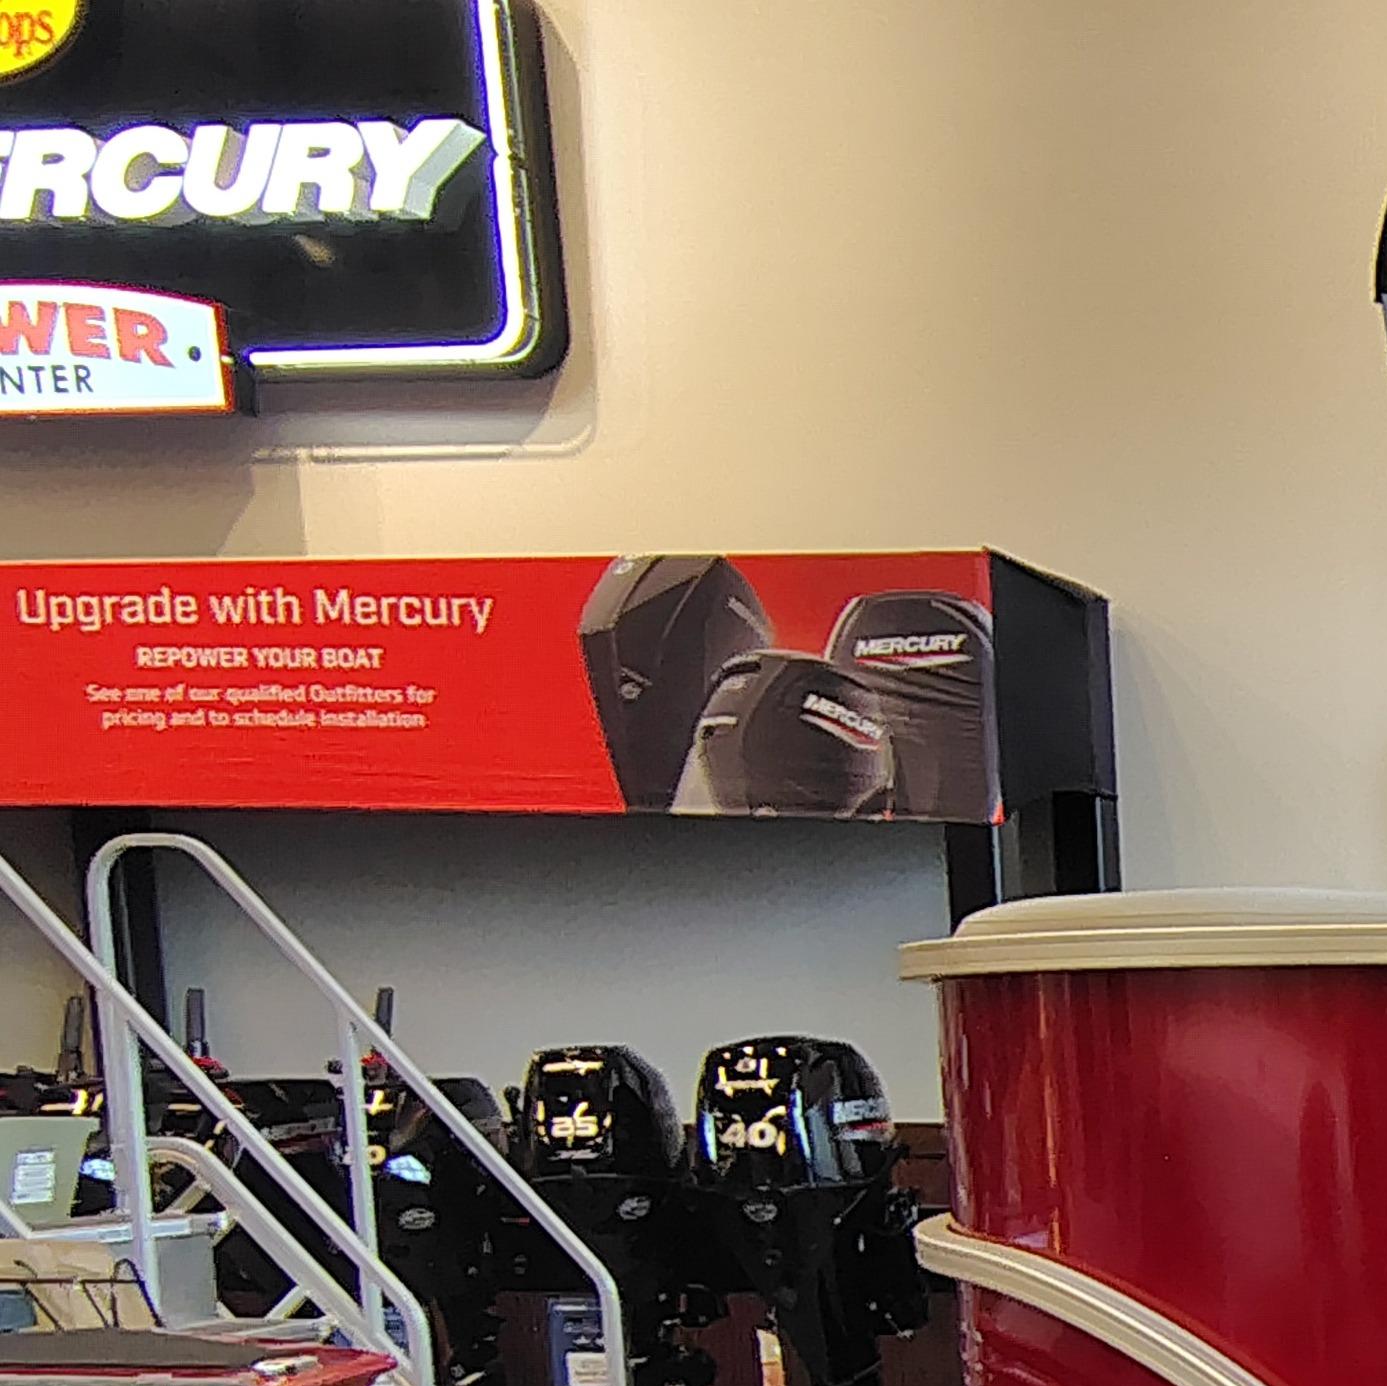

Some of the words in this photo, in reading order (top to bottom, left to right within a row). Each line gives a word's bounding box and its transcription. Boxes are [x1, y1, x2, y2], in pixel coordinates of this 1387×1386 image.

[0, 118, 486, 222] RCURY
[16, 587, 199, 632] Upgrade
[209, 587, 302, 625] with
[314, 588, 493, 634] Mercury
[136, 647, 248, 669] REPOWER
[252, 646, 317, 668] YOUR
[322, 647, 384, 669] BOAT
[854, 634, 968, 658] MERCURY
[85, 684, 123, 702] See
[124, 687, 162, 702] one
[164, 683, 186, 703] of
[225, 684, 307, 706] qualified
[309, 684, 404, 703] Outfitters
[406, 685, 436, 704] for
[102, 708, 168, 731] pricing
[169, 708, 206, 726] and
[208, 710, 231, 726] to
[232, 708, 317, 727] schedule
